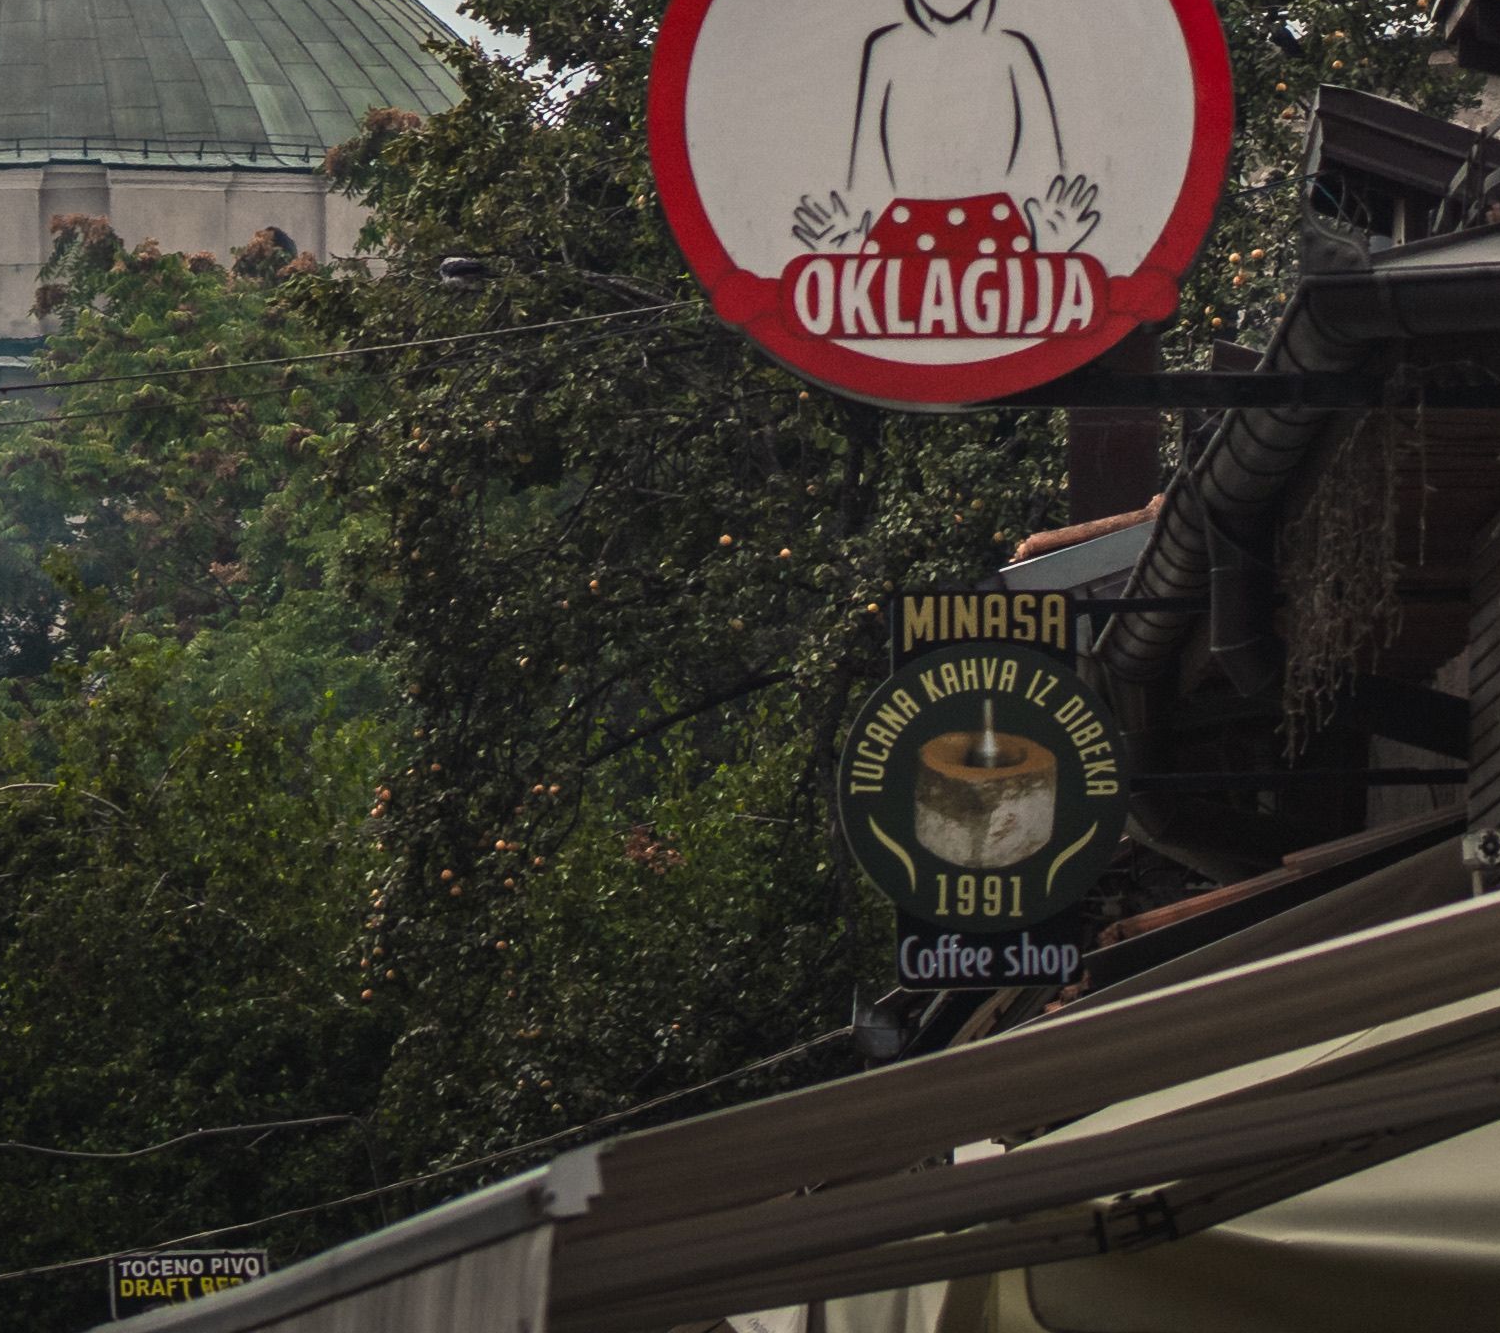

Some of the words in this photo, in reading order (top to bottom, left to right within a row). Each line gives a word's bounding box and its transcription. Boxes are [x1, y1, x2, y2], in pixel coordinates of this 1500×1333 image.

[793, 256, 1094, 335] OKLAGIJA
[902, 593, 1068, 653] MINASA
[850, 688, 922, 795] TUCANA
[919, 657, 1019, 703] KAHVA
[1024, 669, 1060, 708] IZ
[1053, 694, 1120, 797] DIBEKA
[935, 874, 1024, 918] 1991
[900, 935, 993, 980] Coffee
[1004, 932, 1080, 983] shop
[120, 1277, 194, 1301] DRAFT
[210, 1256, 261, 1277] PIVO
